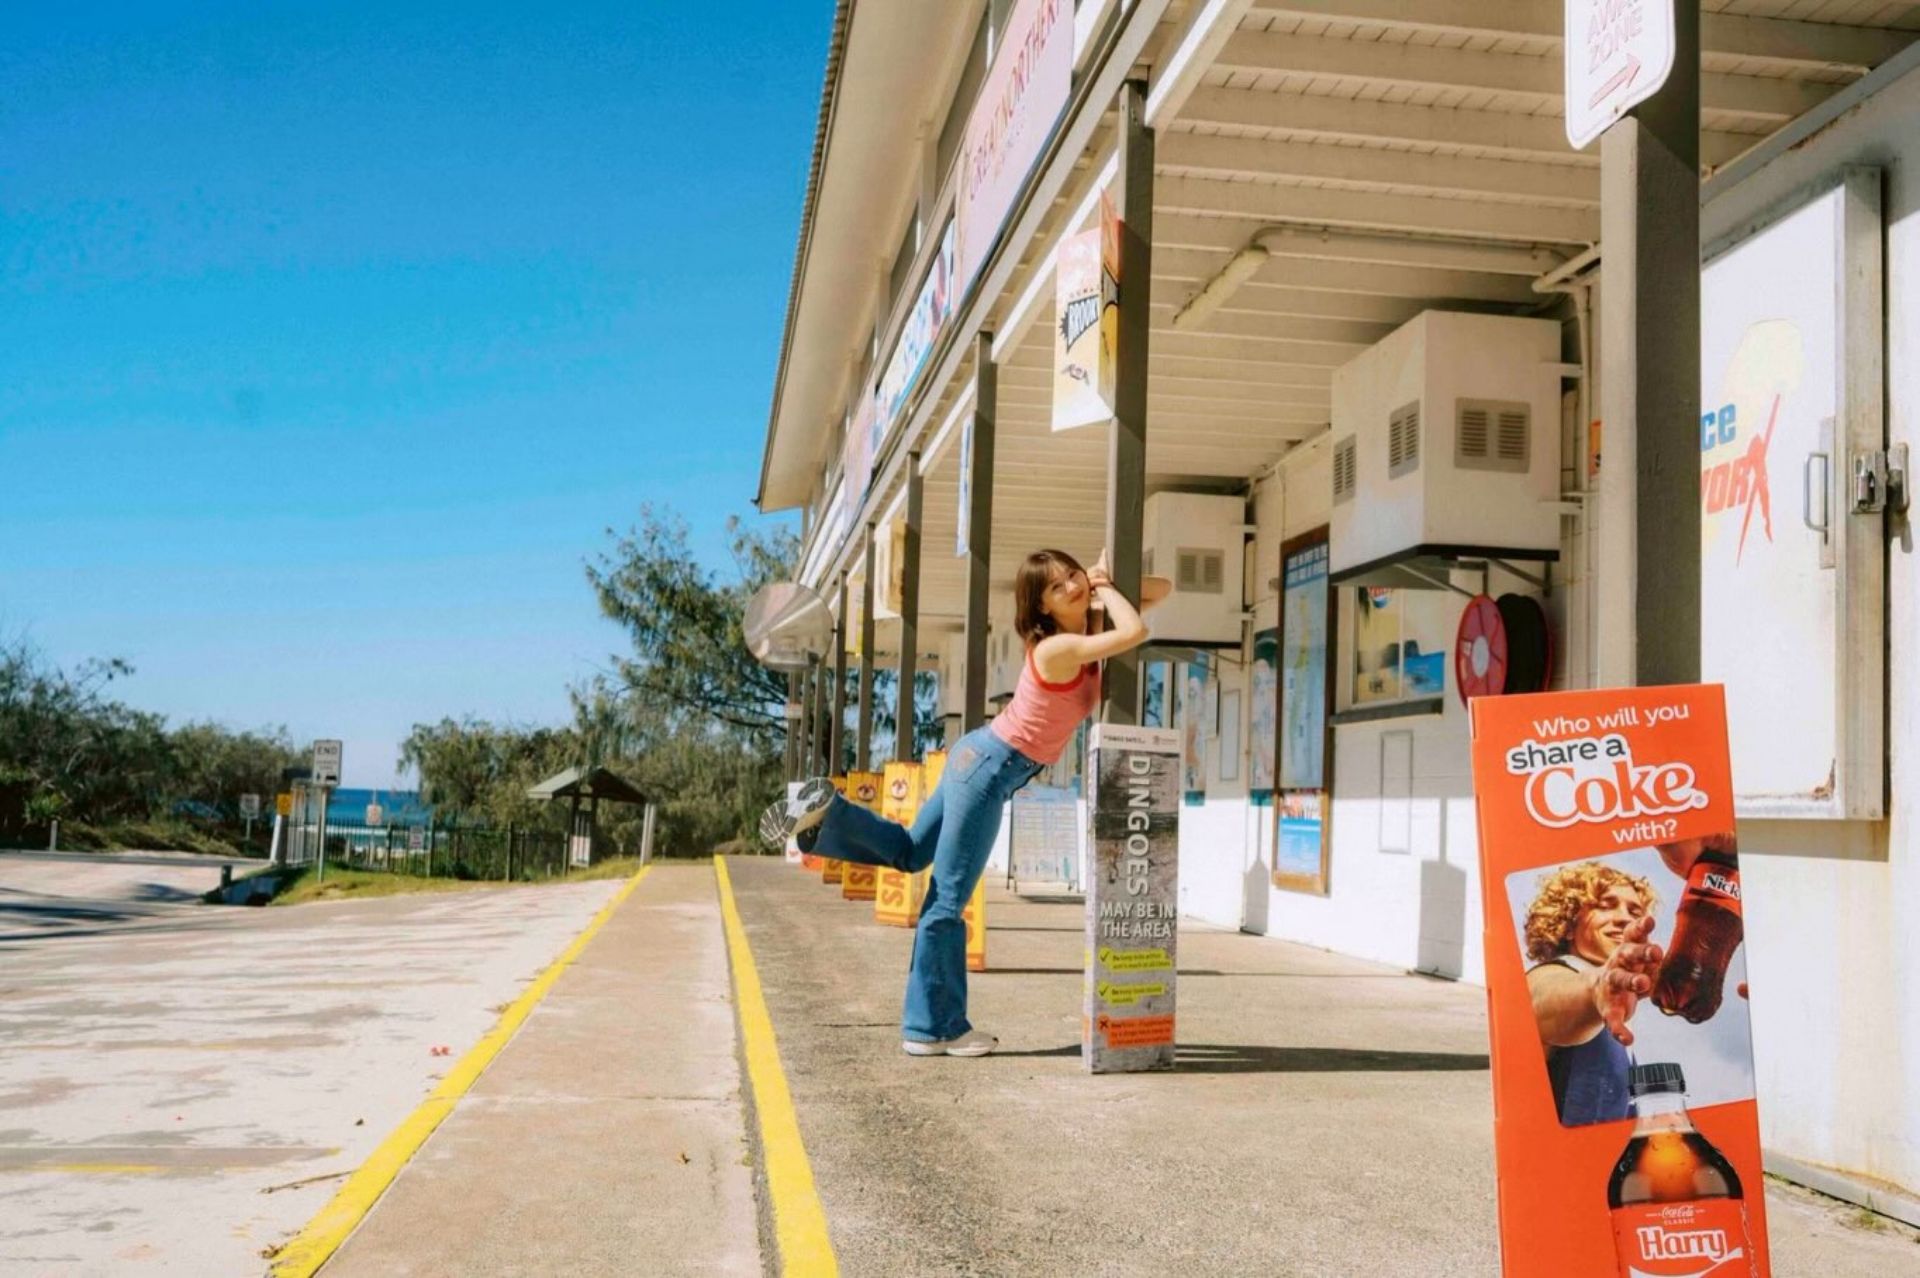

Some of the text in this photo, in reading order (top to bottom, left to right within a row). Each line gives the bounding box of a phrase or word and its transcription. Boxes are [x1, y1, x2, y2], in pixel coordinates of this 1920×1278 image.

[1588, 6, 1643, 76] ZONE
[1001, 0, 1060, 138] NORTHER
[1533, 703, 1690, 738] Who will you
[317, 746, 338, 755] END
[1510, 738, 1626, 770] share a
[1527, 761, 1696, 827] Coke
[1126, 755, 1151, 897] DINGOES
[1612, 818, 1678, 844] with?
[1100, 902, 1175, 919] MAY BE IN
[1103, 921, 1172, 938] THE AREA
[1637, 1227, 1727, 1264] Harry
